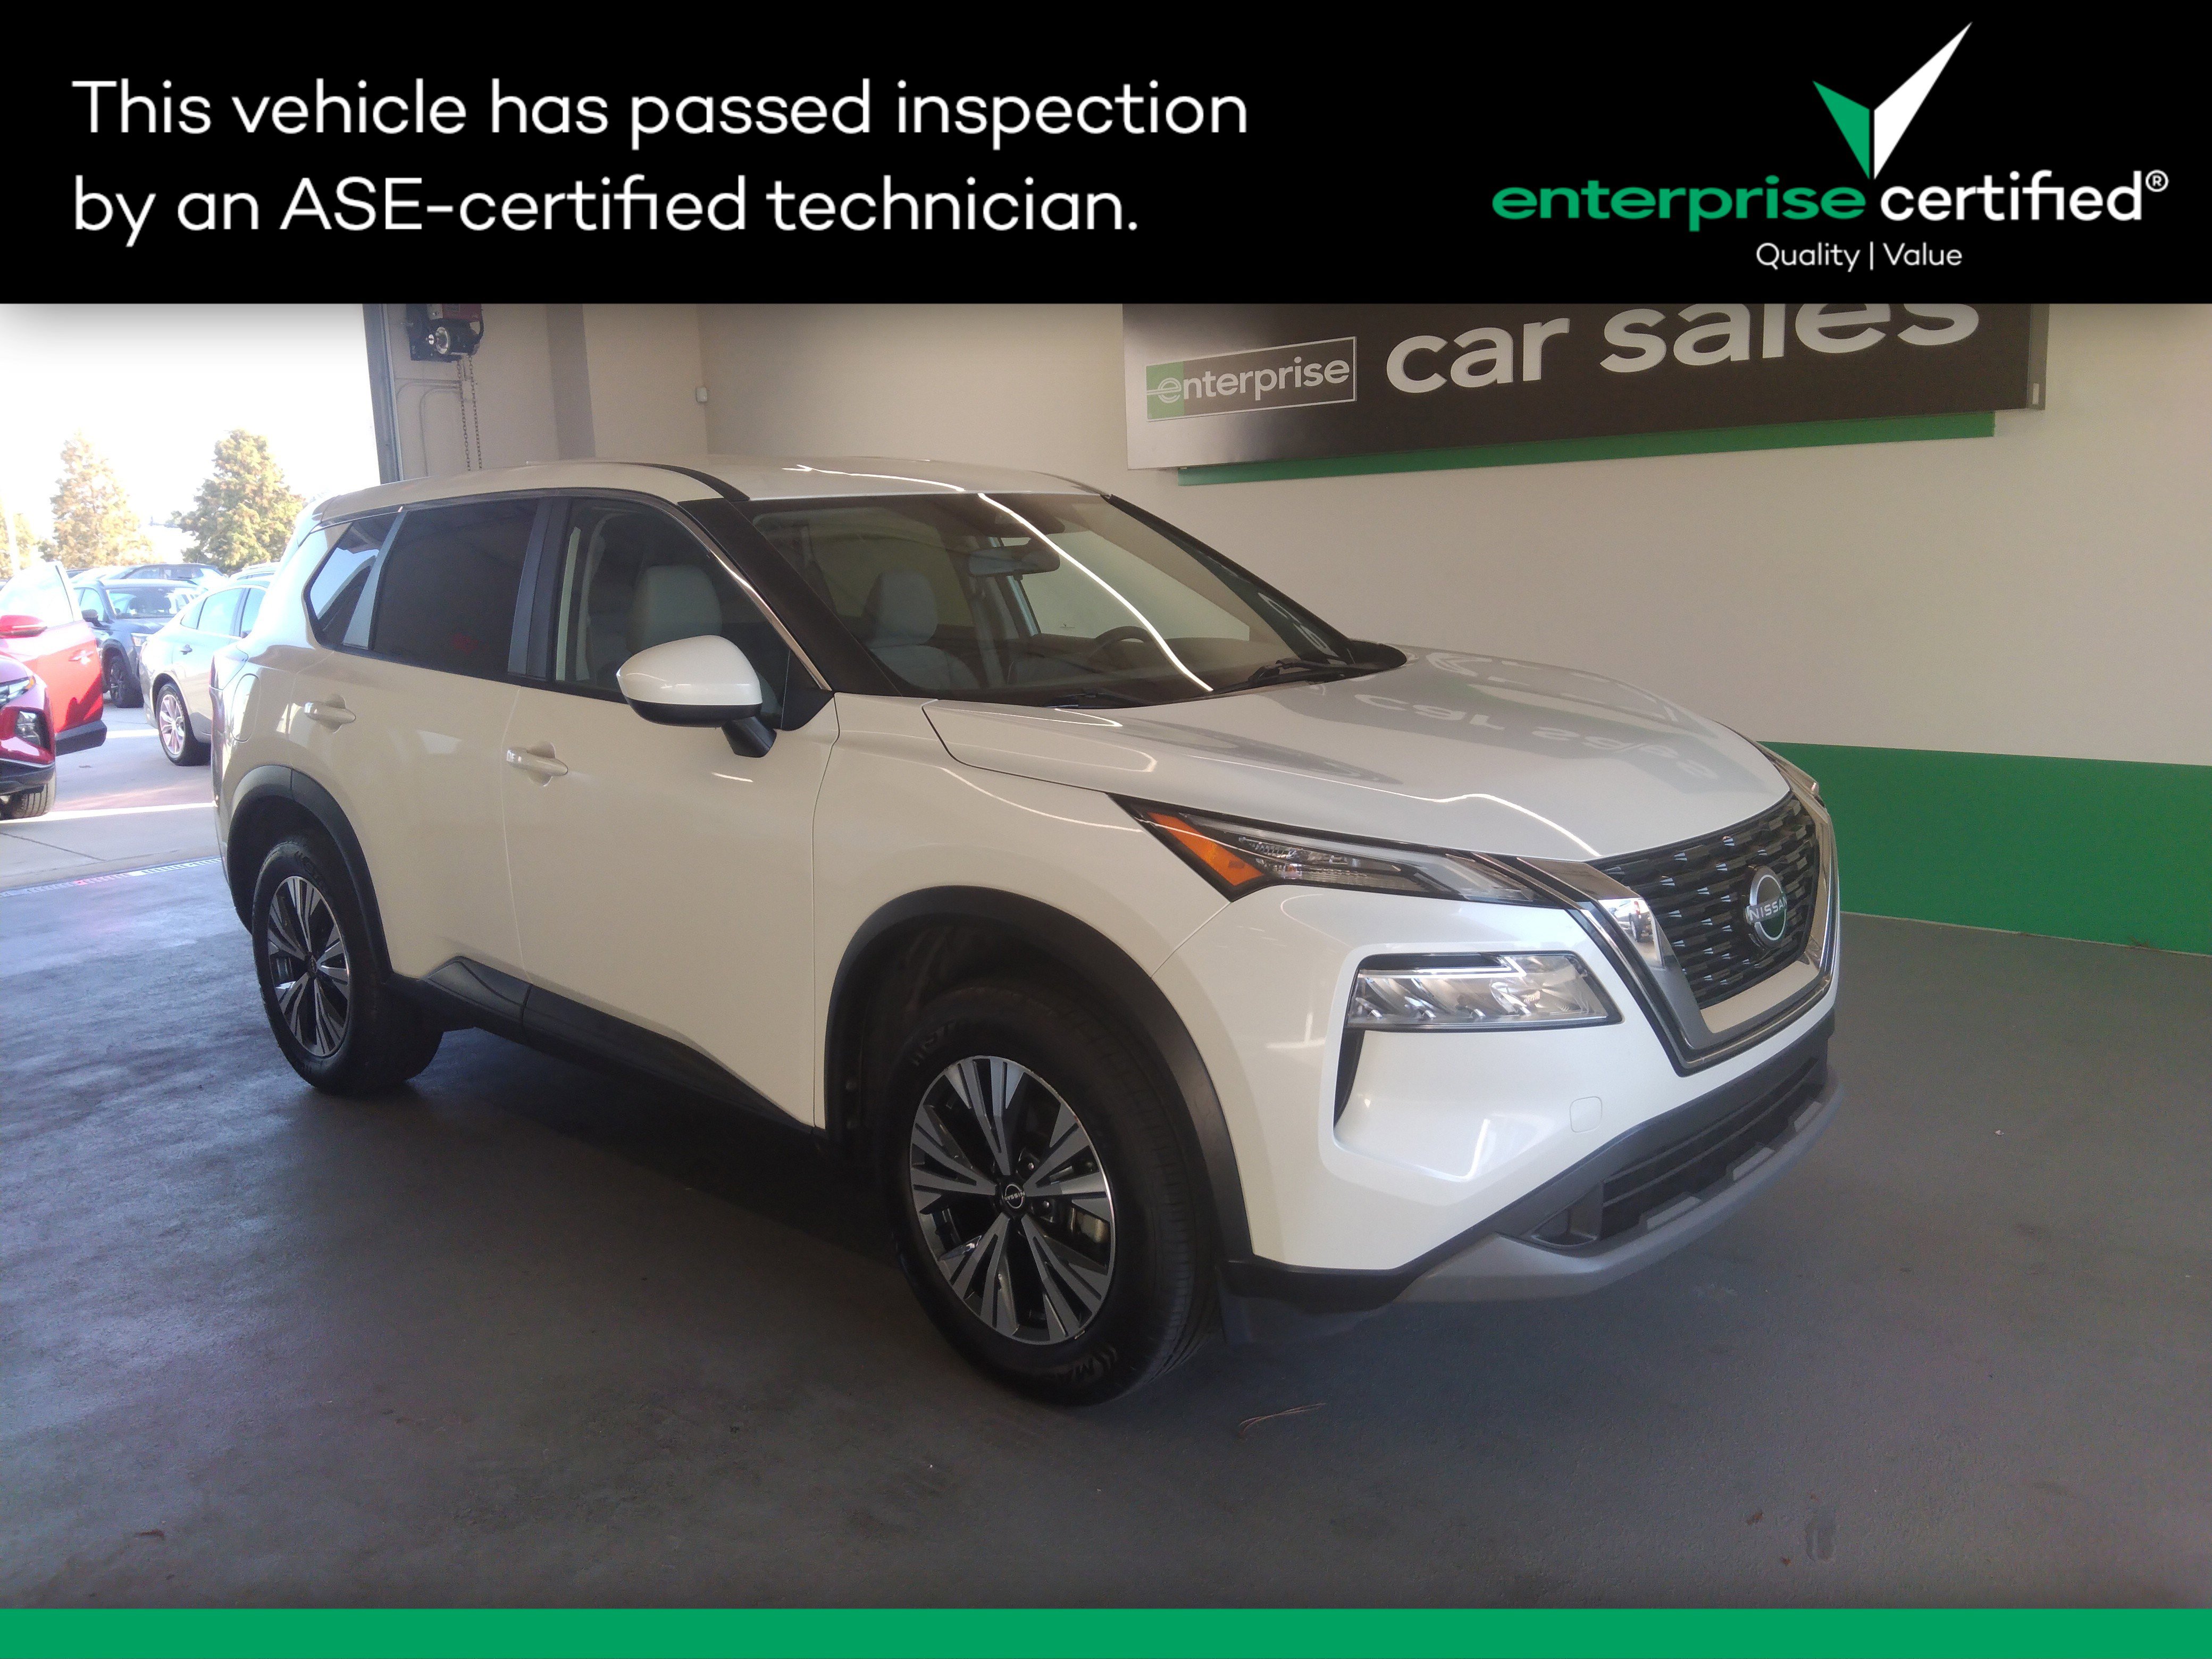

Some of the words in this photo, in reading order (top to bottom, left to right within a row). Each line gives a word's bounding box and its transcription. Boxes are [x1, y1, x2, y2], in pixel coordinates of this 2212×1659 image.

[1149, 356, 1350, 404] enterprise
[1386, 317, 1570, 393] car
[1600, 304, 1980, 373] sales
[1748, 896, 1787, 921] NISSAN
